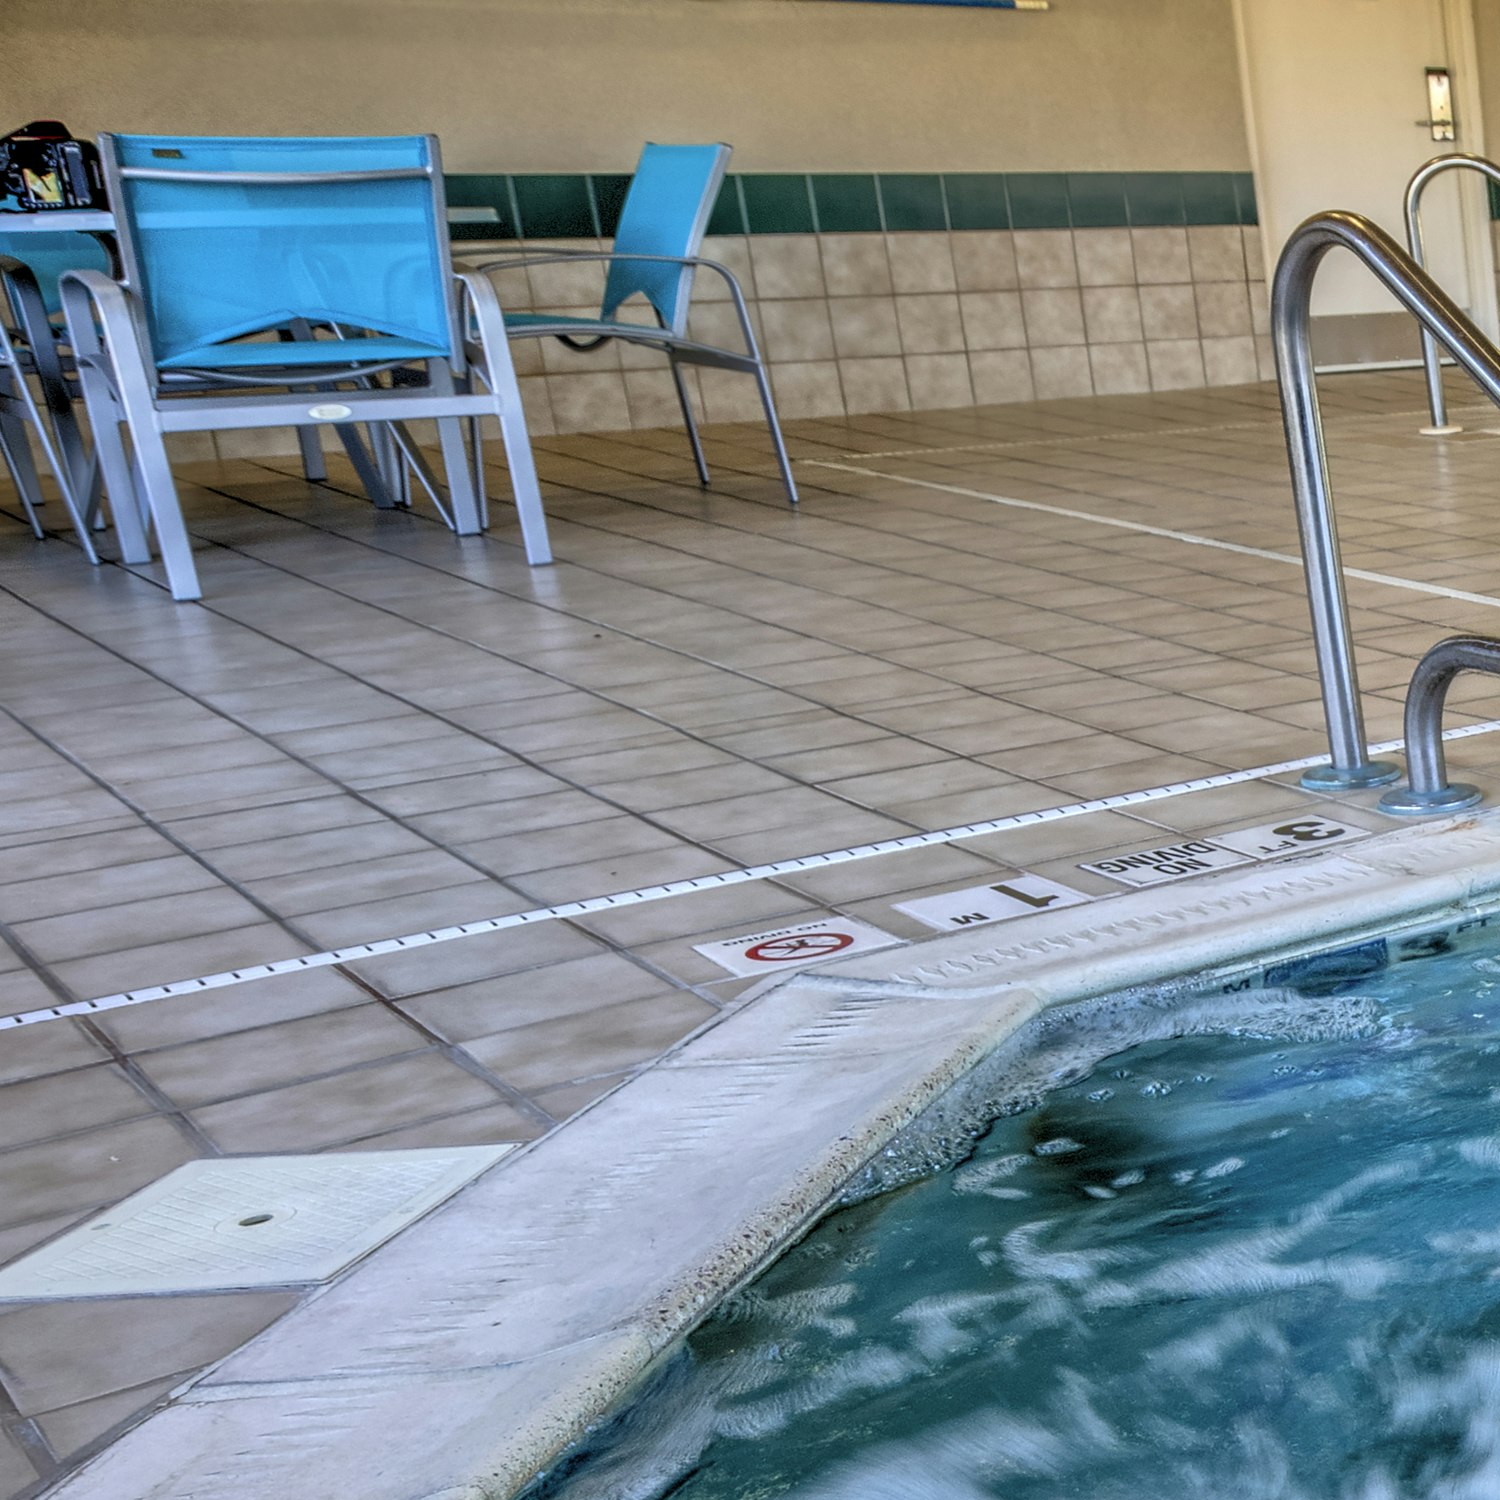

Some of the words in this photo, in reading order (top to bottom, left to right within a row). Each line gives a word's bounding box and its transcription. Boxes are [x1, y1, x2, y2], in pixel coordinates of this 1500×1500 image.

[1272, 820, 1346, 842] 3
[1257, 840, 1298, 854] FT
[1095, 841, 1217, 875] DIVING
[1152, 858, 1212, 876] NO
[988, 884, 1060, 908] 1
[798, 923, 827, 931] NO
[949, 911, 990, 926] M
[1456, 916, 1491, 935] FT
[722, 930, 791, 946] DIVING
[1222, 978, 1251, 994] M
